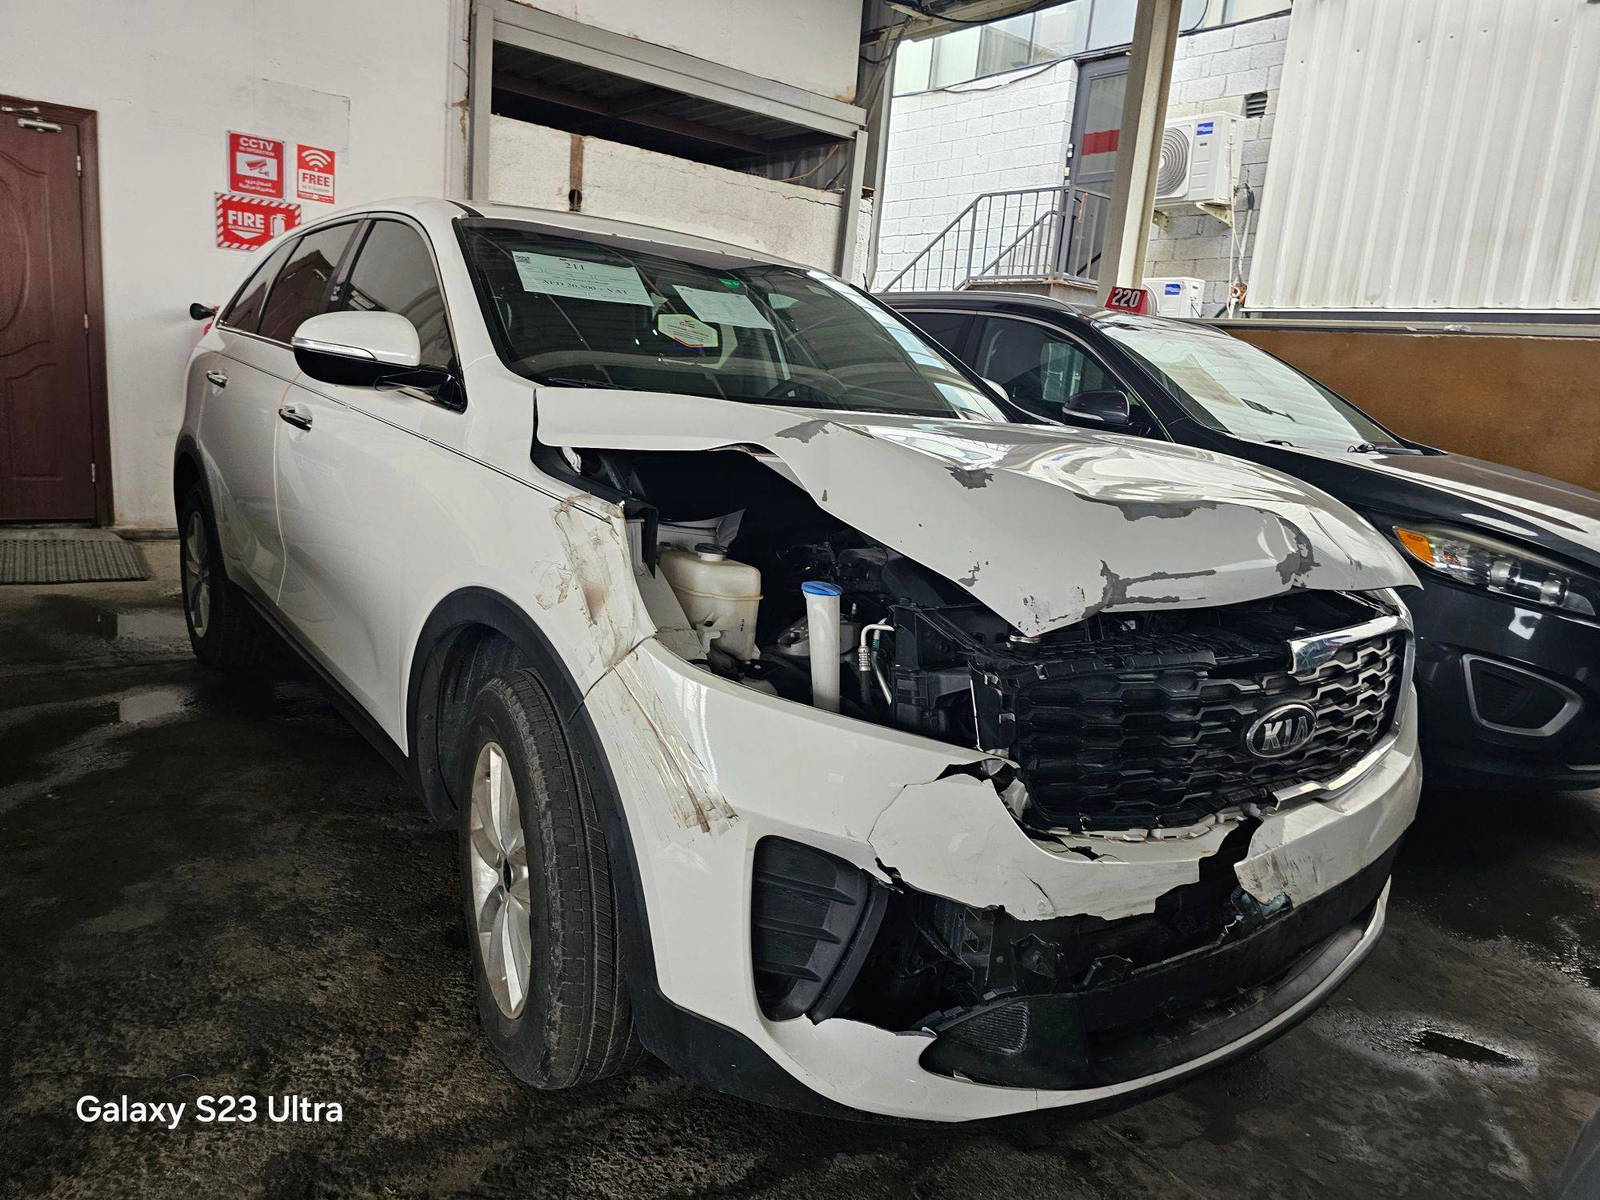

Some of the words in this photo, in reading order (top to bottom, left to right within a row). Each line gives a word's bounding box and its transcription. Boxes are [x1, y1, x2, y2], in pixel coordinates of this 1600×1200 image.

[239, 137, 274, 151] CCTV
[302, 173, 330, 187] FREE
[227, 210, 265, 228] FIRE
[565, 262, 585, 271] 211
[1111, 289, 1141, 308] 220
[1261, 716, 1309, 751] KIA
